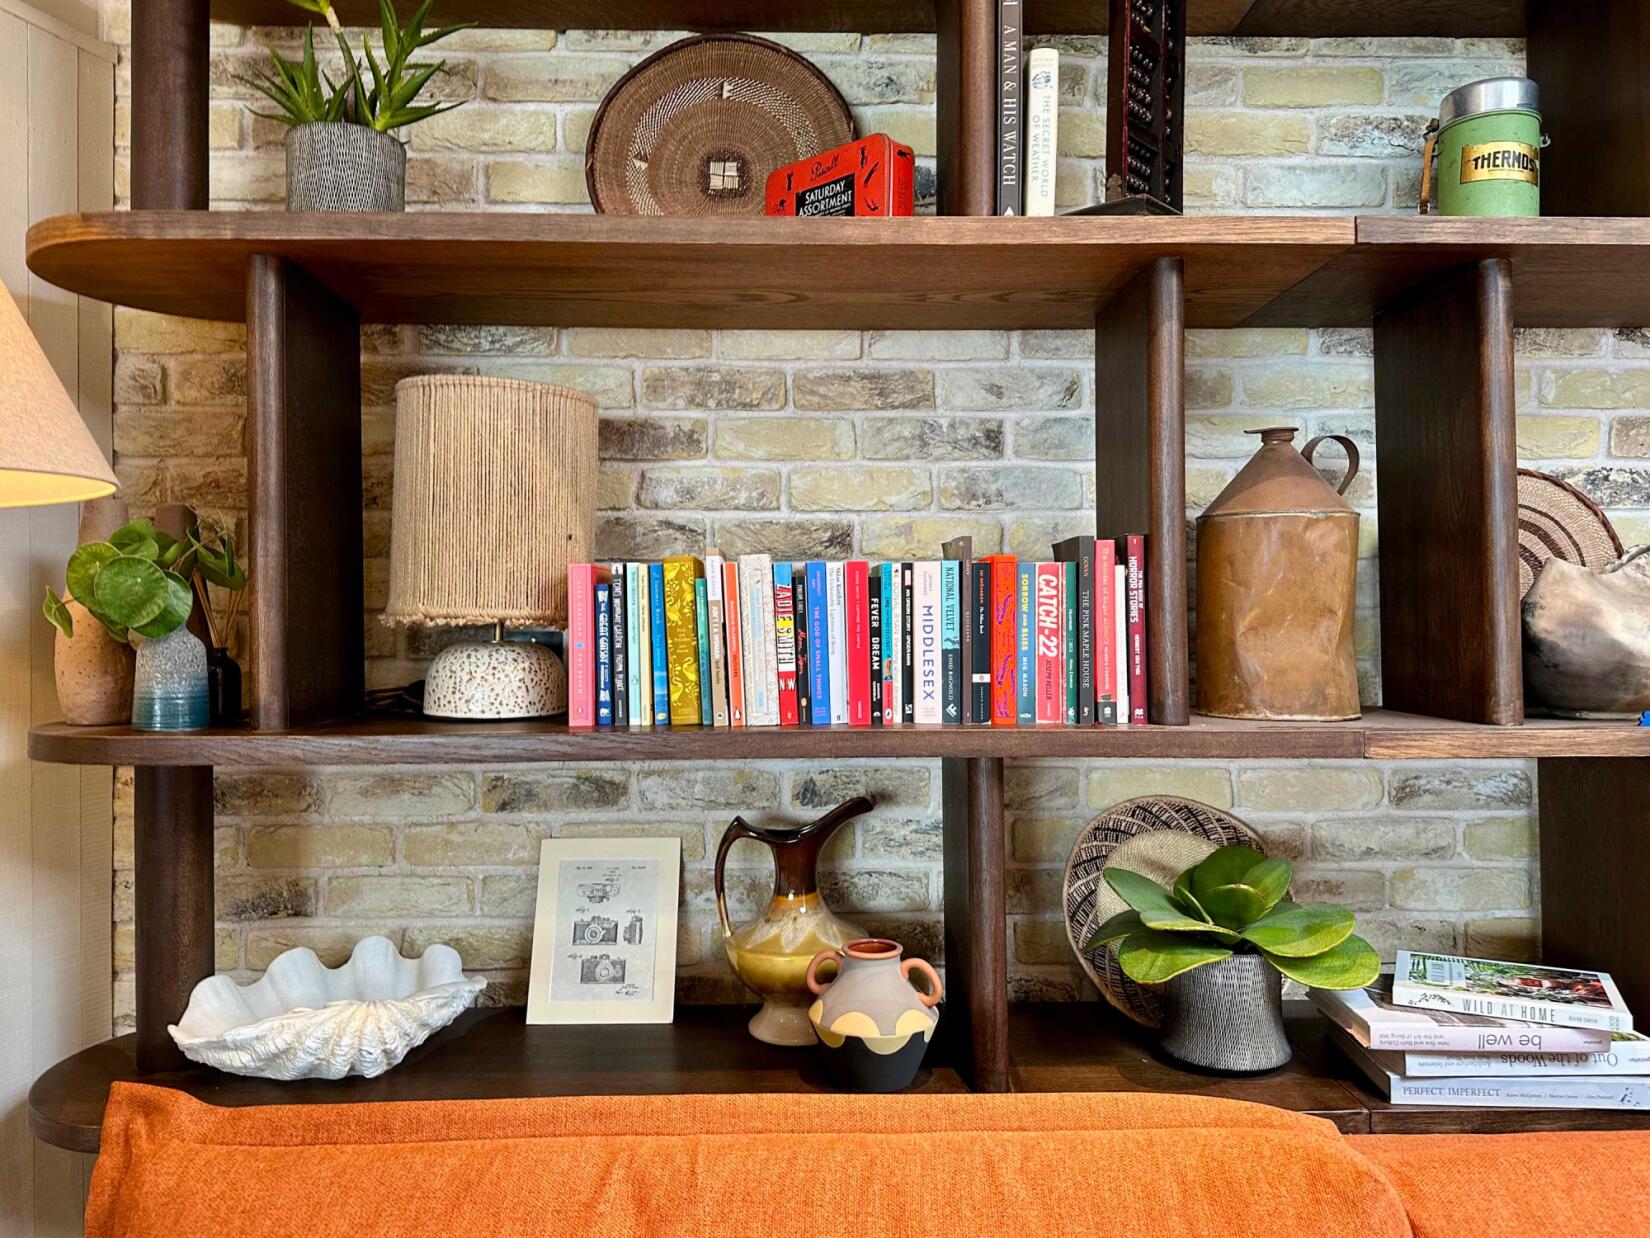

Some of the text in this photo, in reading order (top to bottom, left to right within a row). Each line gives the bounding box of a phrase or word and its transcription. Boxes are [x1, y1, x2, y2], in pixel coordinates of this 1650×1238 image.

[1002, 25, 1017, 186] A MAN & HIS WATCH
[1031, 114, 1040, 182] OF WEATHER
[1040, 95, 1051, 198] THE SECRET WORLD
[1472, 150, 1536, 172] THERMOS
[798, 190, 853, 217] ASSORTMENT
[805, 180, 846, 204] SATURDAY
[946, 566, 955, 631] NATIONAL VELVET
[1021, 574, 1029, 612] SORROW
[1129, 556, 1138, 623] HORROR STORIES
[600, 612, 608, 636] GREAT
[712, 606, 720, 622] AIN'T
[776, 584, 794, 664] ZADIE SMITH
[870, 598, 880, 628] FEVER
[1038, 574, 1058, 657] CATCH-22
[614, 624, 622, 648] GARDEN
[713, 634, 721, 659] WOMAN
[815, 638, 820, 648] OF
[600, 636, 609, 664] GATSBY
[872, 636, 880, 670] DREAM
[922, 604, 935, 700] MIDDLESEX
[1462, 998, 1492, 1014] WILD
[1501, 1003, 1514, 1017] AT
[1521, 1006, 1556, 1022] HOME
[1478, 1034, 1542, 1050] be well
[1500, 1054, 1548, 1067] Woods
[1548, 1054, 1570, 1067] the
[1574, 1054, 1589, 1067] of
[1590, 1053, 1618, 1067] Out
[1402, 1086, 1502, 1097] PERFECT IMPERFECT
